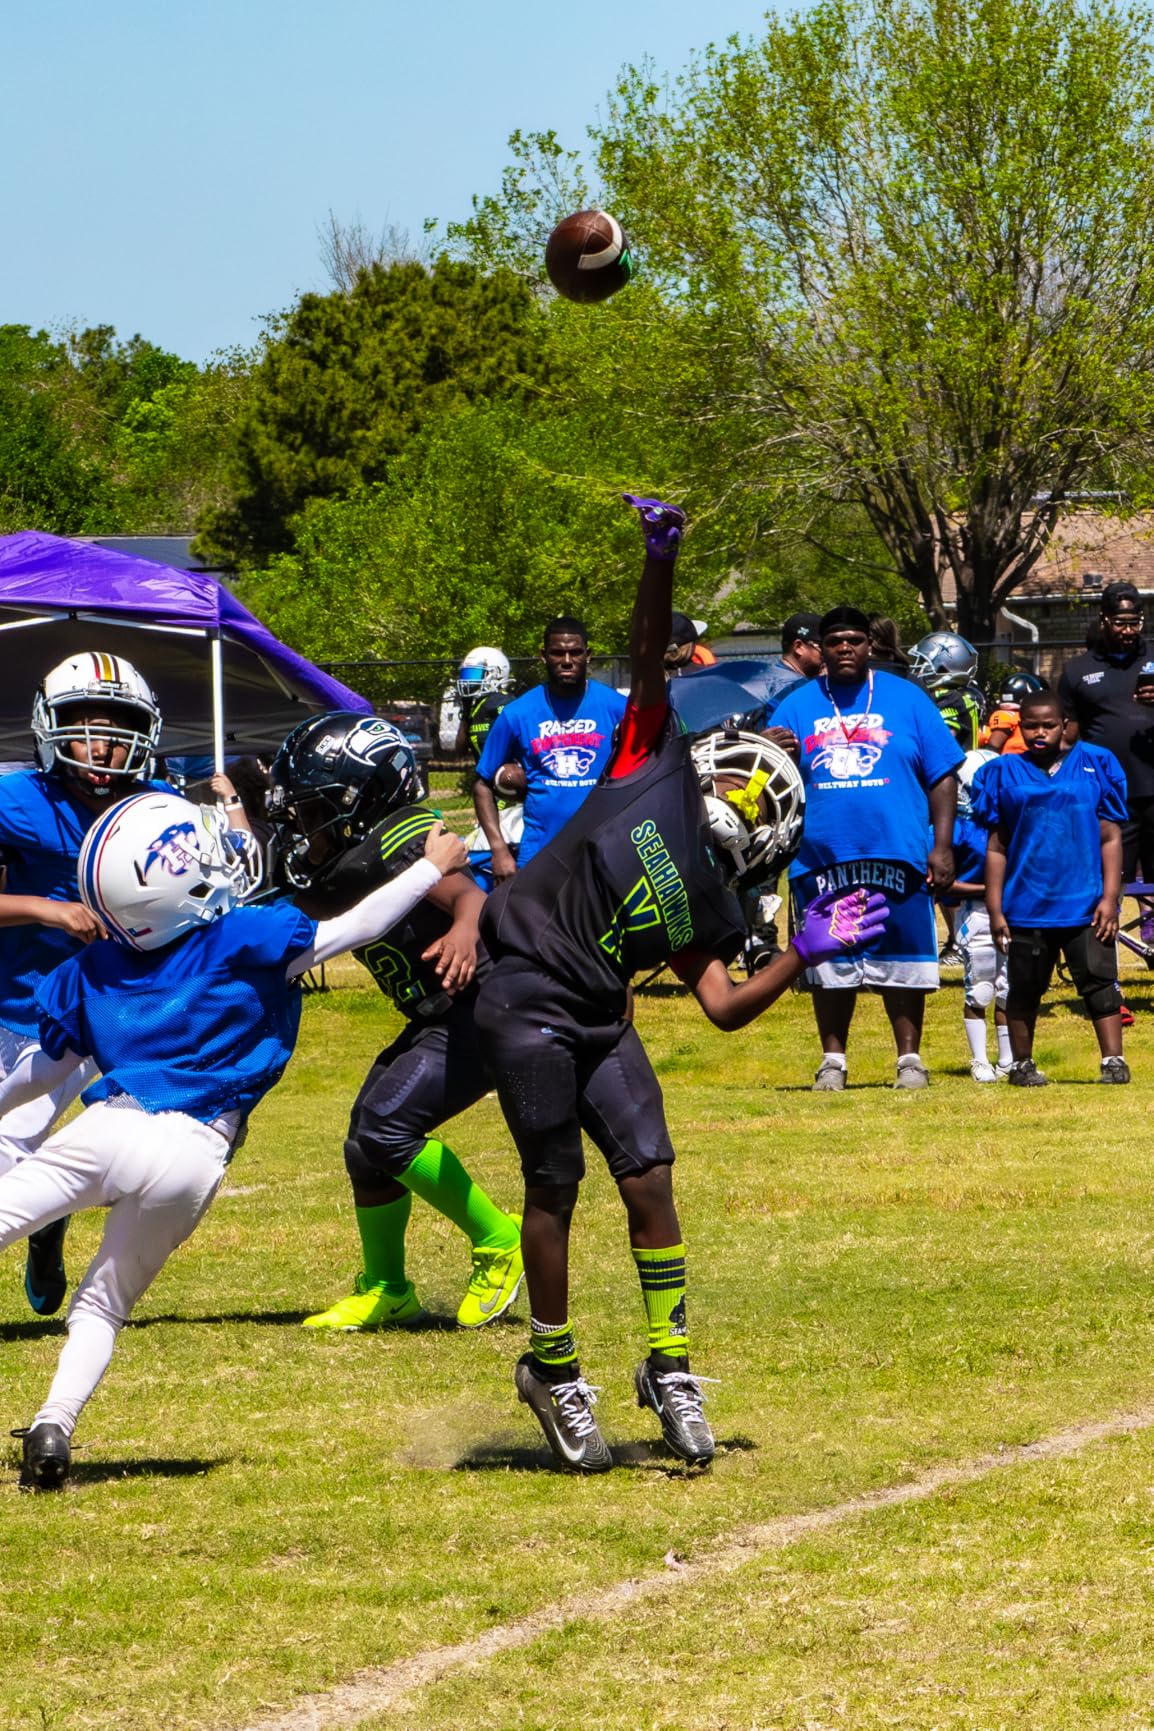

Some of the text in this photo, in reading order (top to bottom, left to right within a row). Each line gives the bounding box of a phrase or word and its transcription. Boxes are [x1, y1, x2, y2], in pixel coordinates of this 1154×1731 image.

[538, 719, 597, 739] RAISED
[814, 712, 884, 736] RAISED
[631, 819, 694, 951] SEAHAWKS
[816, 862, 905, 896] PANTHERS
